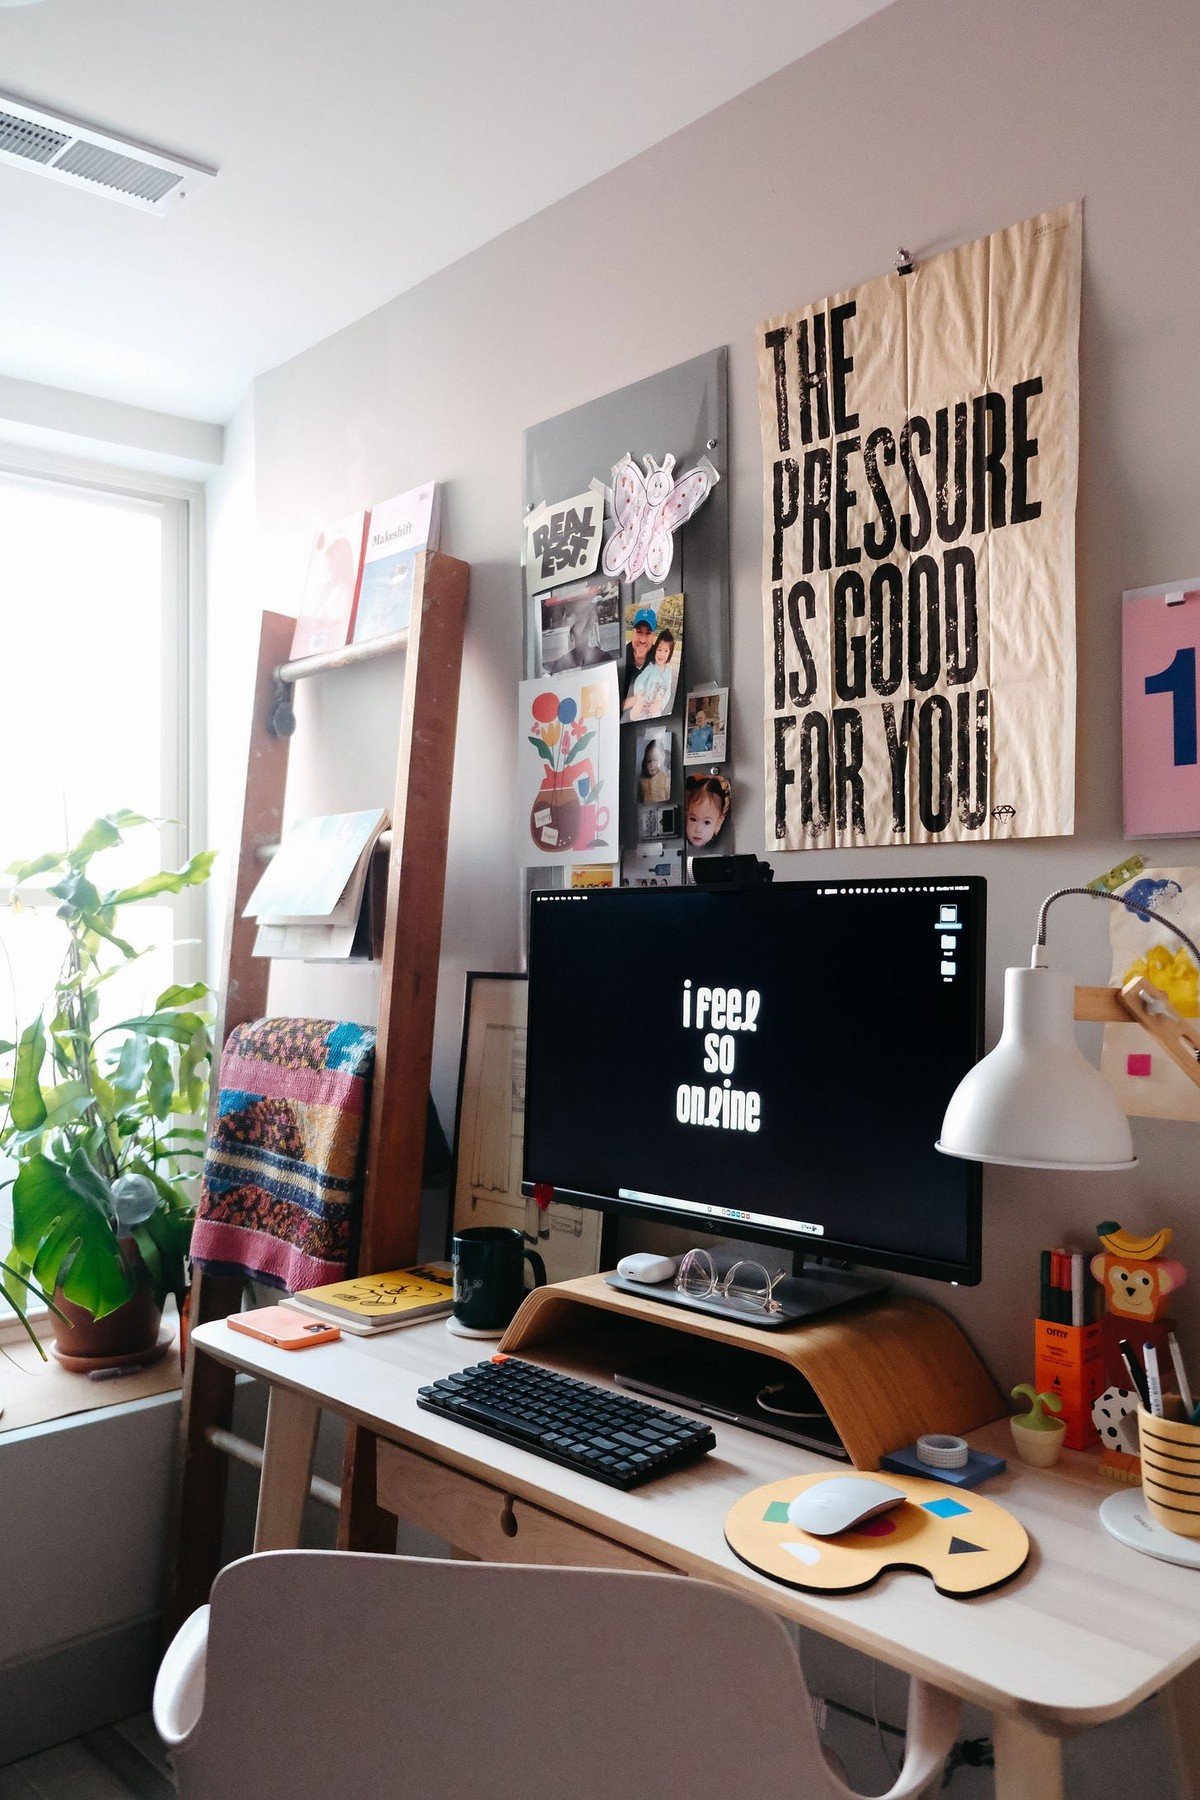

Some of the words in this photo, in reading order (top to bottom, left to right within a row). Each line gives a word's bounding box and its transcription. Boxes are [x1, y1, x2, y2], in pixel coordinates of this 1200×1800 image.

[765, 301, 859, 452] THE
[772, 375, 1043, 581] PRESSURE
[371, 522, 412, 547] Makeshift
[533, 506, 596, 559] REAL
[541, 535, 589, 579] EST.
[772, 581, 817, 711] IS
[835, 546, 978, 703] GOOD
[1144, 647, 1197, 767] 1
[774, 706, 864, 840] FOR
[882, 690, 990, 834] YOU
[682, 978, 692, 1028] i
[696, 987, 761, 1032] feel
[703, 1032, 735, 1075] so
[676, 1078, 761, 1133] online
[1046, 1327, 1069, 1339] omy
